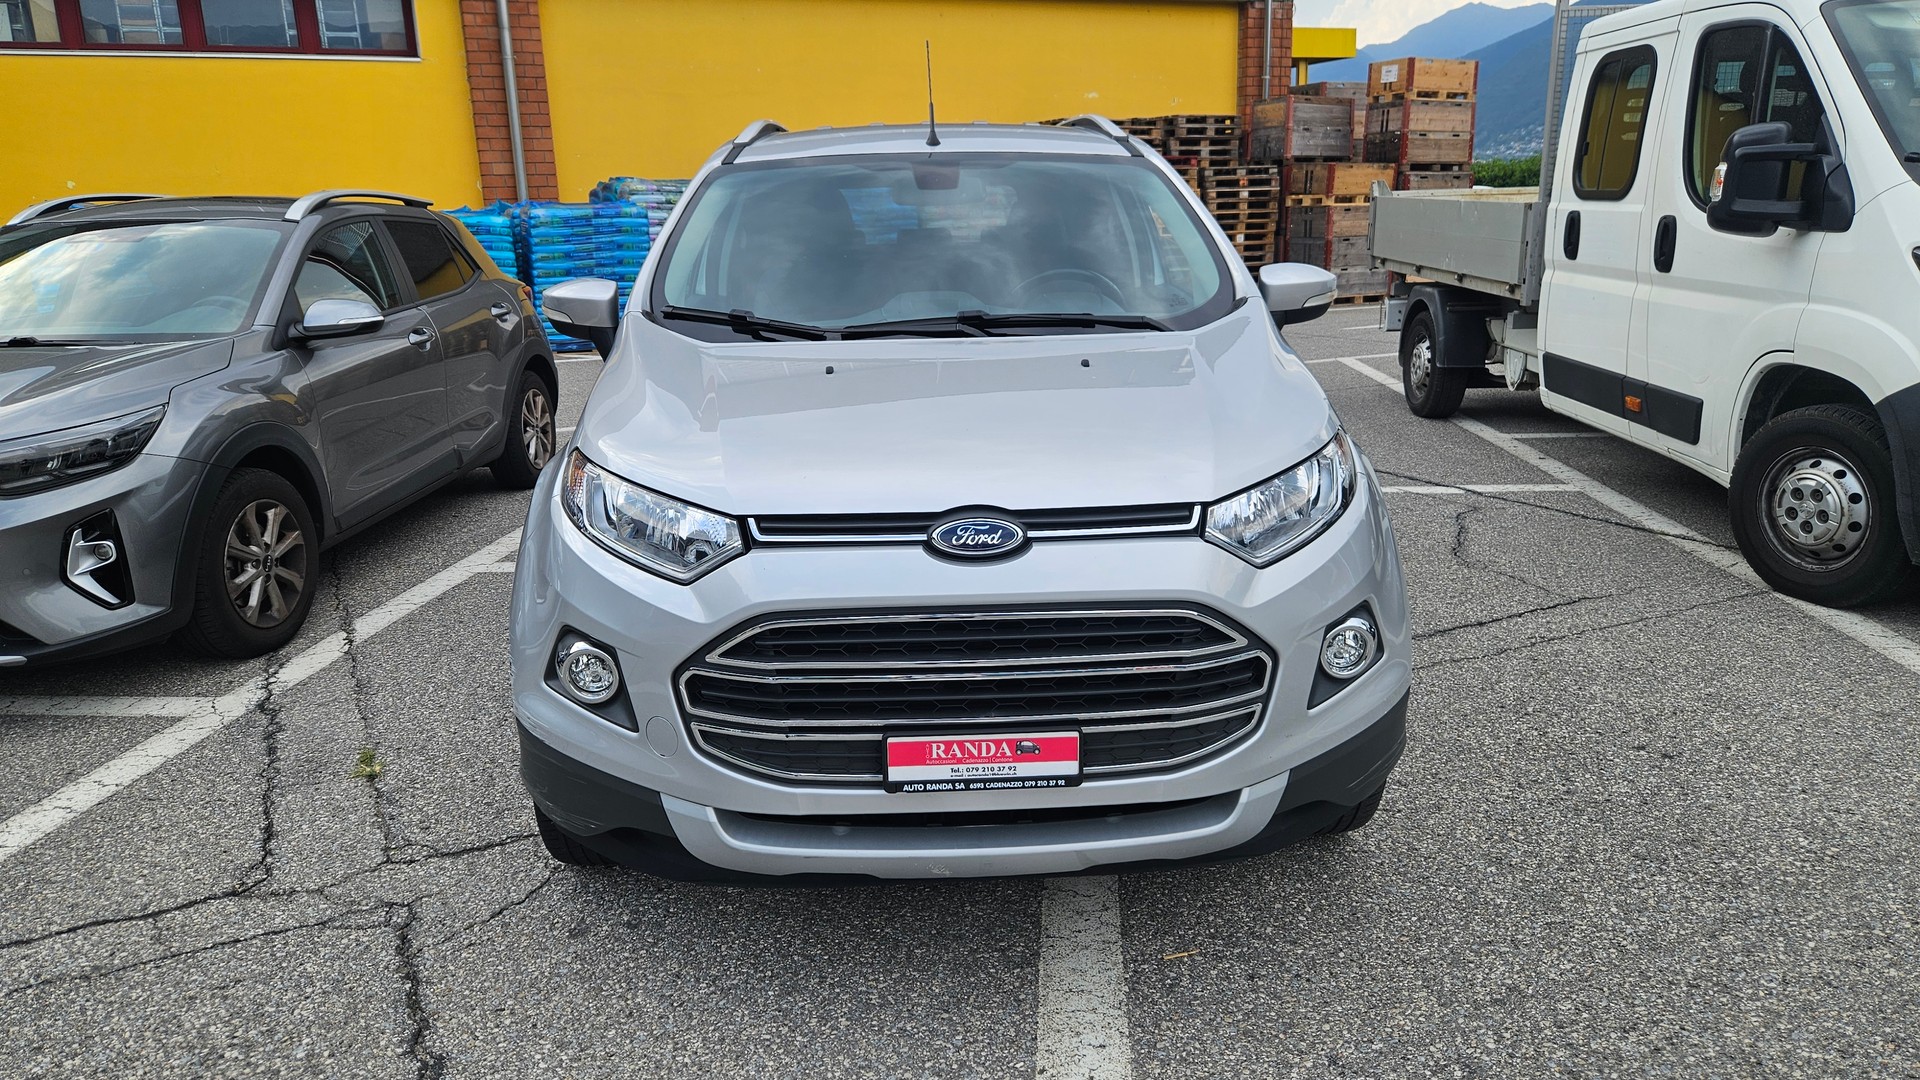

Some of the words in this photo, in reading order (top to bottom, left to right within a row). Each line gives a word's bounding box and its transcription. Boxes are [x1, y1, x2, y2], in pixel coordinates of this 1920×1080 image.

[952, 525, 1002, 545] Ford
[931, 741, 1013, 759] RANDA
[926, 783, 953, 791] RANDA
